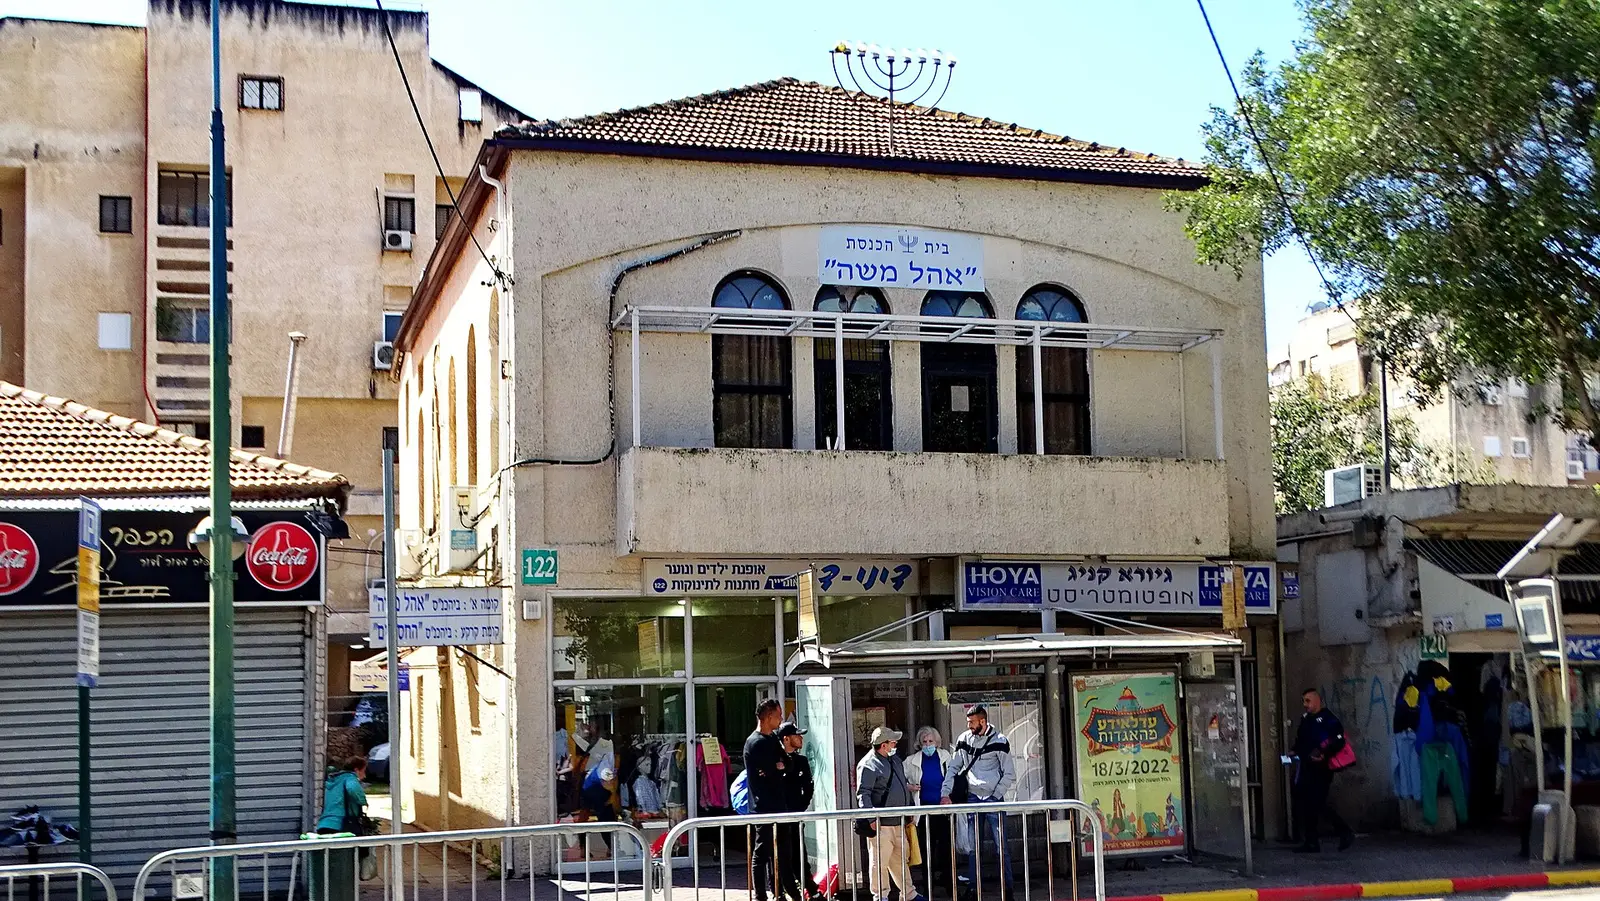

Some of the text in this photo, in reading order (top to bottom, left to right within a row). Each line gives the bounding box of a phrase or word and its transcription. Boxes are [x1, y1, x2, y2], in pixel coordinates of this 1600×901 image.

[846, 237, 949, 254] בית הכנסת
[824, 258, 977, 285] "אהל משה"
[108, 526, 174, 547] הכפר
[525, 556, 556, 578] 122
[665, 562, 766, 575] אופנת ילדים ונוער
[971, 567, 1040, 585] HOYA
[1068, 565, 1173, 586] גיורא קניג
[1203, 570, 1268, 588] HYA
[671, 578, 759, 592] מתנות לתינוקות
[968, 587, 1041, 598] VISION CARE
[1284, 586, 1299, 595] 122
[1047, 588, 1194, 604] אופטומטריסט
[480, 598, 499, 612] קומה
[460, 626, 479, 640] קרקע
[481, 626, 500, 640] קומת
[1422, 636, 1446, 654] 120
[1097, 716, 1157, 731] עדלאידע
[1098, 729, 1158, 743] מהאגדות
[1092, 758, 1169, 777] 18/3/2022
